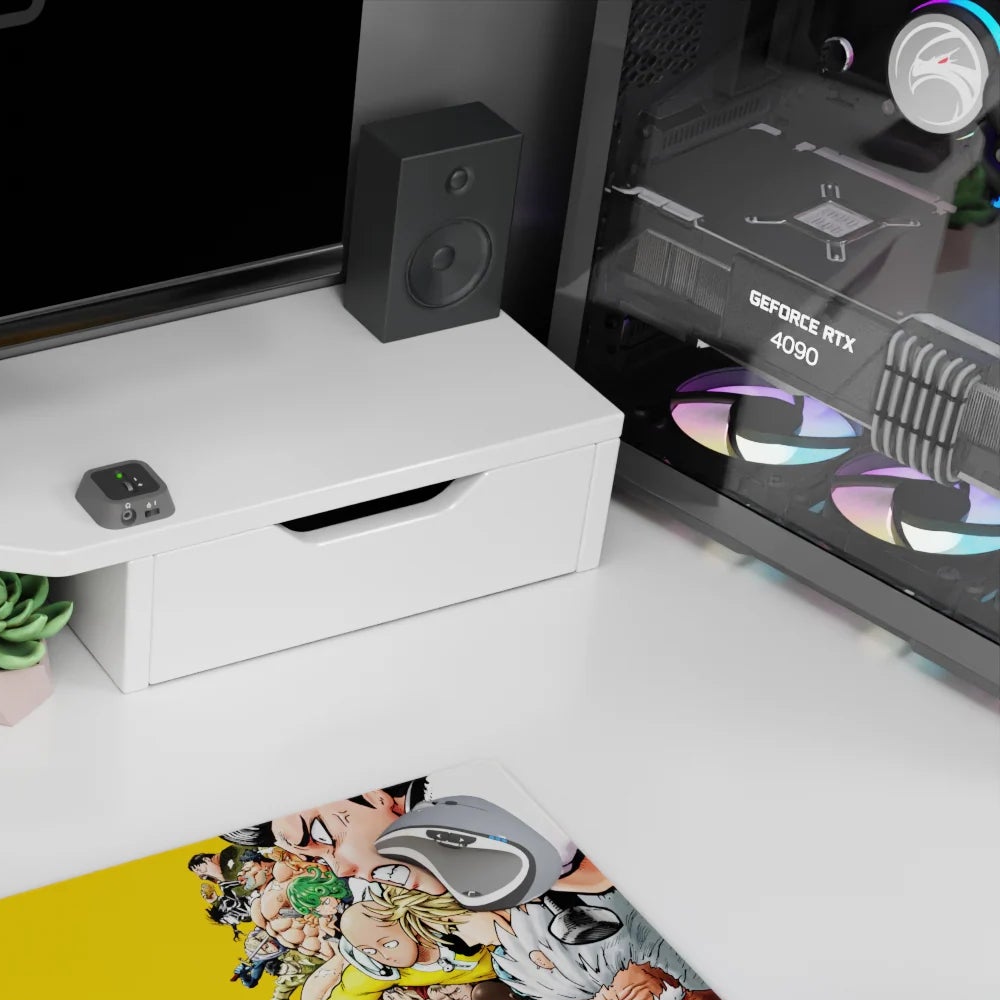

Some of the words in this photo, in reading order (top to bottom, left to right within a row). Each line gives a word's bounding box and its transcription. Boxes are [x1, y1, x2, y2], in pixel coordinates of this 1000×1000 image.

[749, 289, 821, 336] GEFORCE
[822, 324, 857, 354] RTX
[769, 331, 819, 366] 4090
